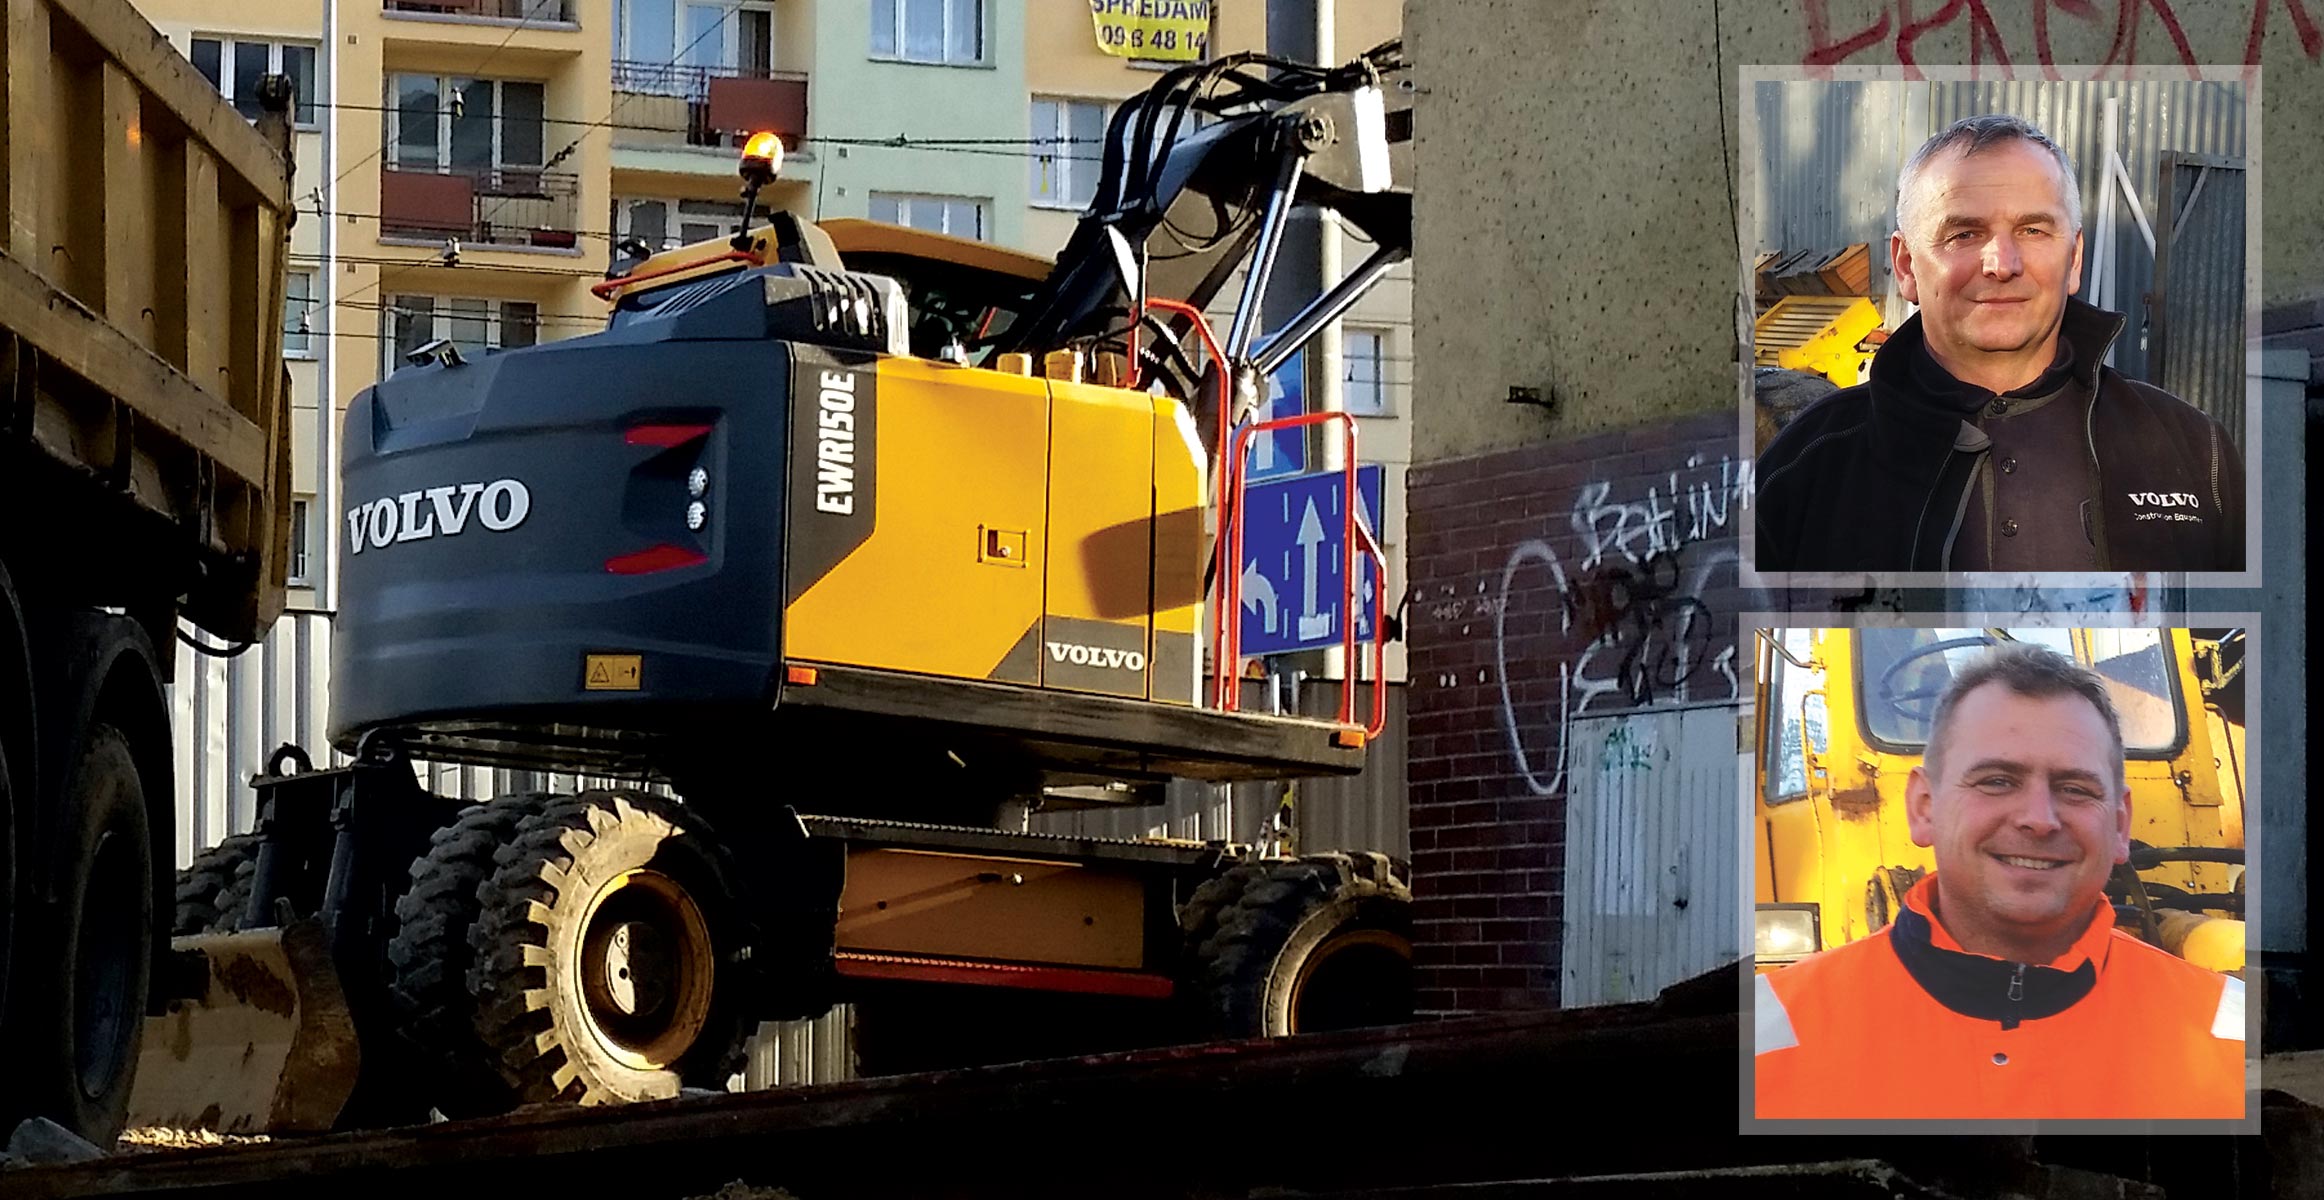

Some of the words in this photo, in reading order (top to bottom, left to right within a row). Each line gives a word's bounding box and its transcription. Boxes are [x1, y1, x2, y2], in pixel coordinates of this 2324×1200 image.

[1150, 29, 1176, 50] 48
[816, 370, 855, 516] EWR150E
[348, 477, 531, 555] VOLVO
[2128, 492, 2199, 509] VOLVO
[1046, 641, 1146, 672] VOLVO
